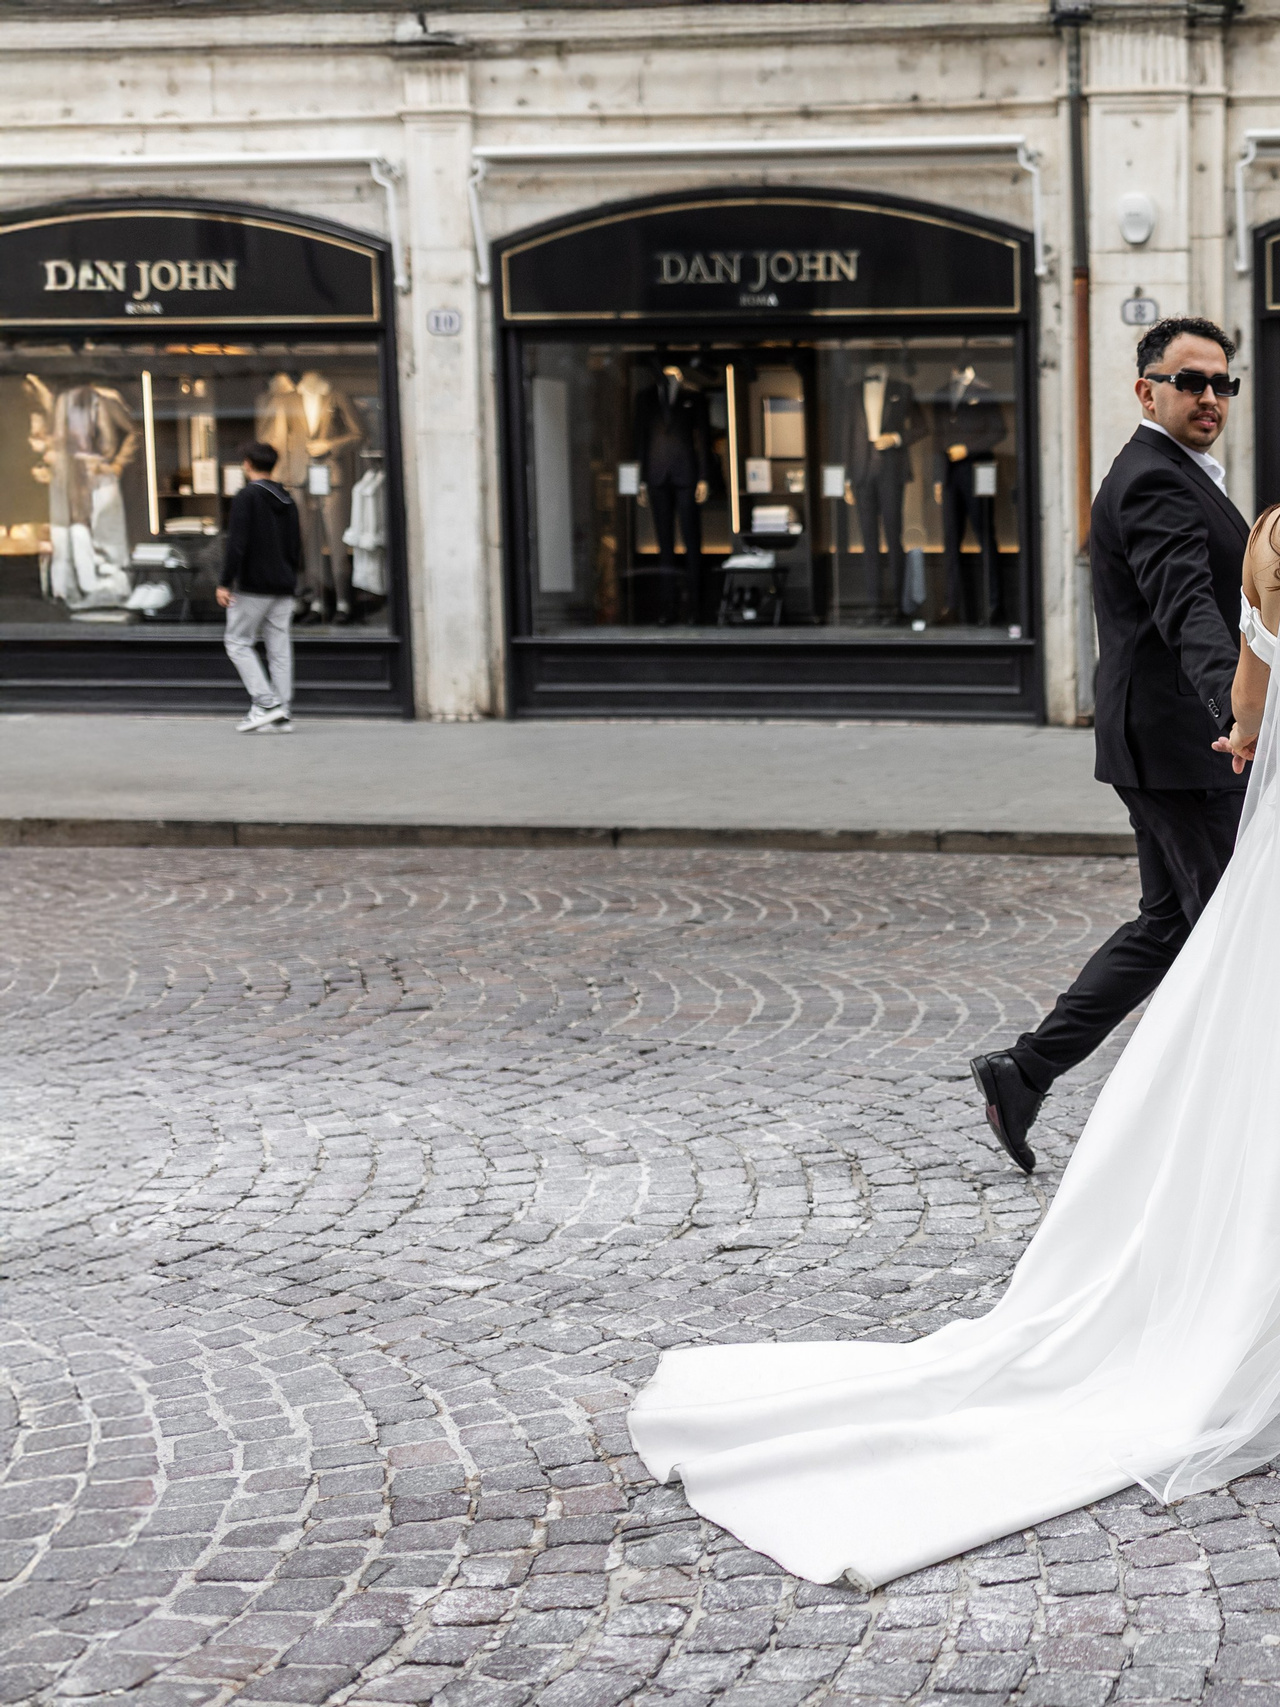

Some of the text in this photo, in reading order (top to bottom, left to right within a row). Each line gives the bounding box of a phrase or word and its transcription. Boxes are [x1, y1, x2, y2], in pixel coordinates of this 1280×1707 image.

[43, 259, 237, 301] DAN JOHN
[656, 250, 860, 293] DAN JOHN
[434, 315, 454, 332] 10
